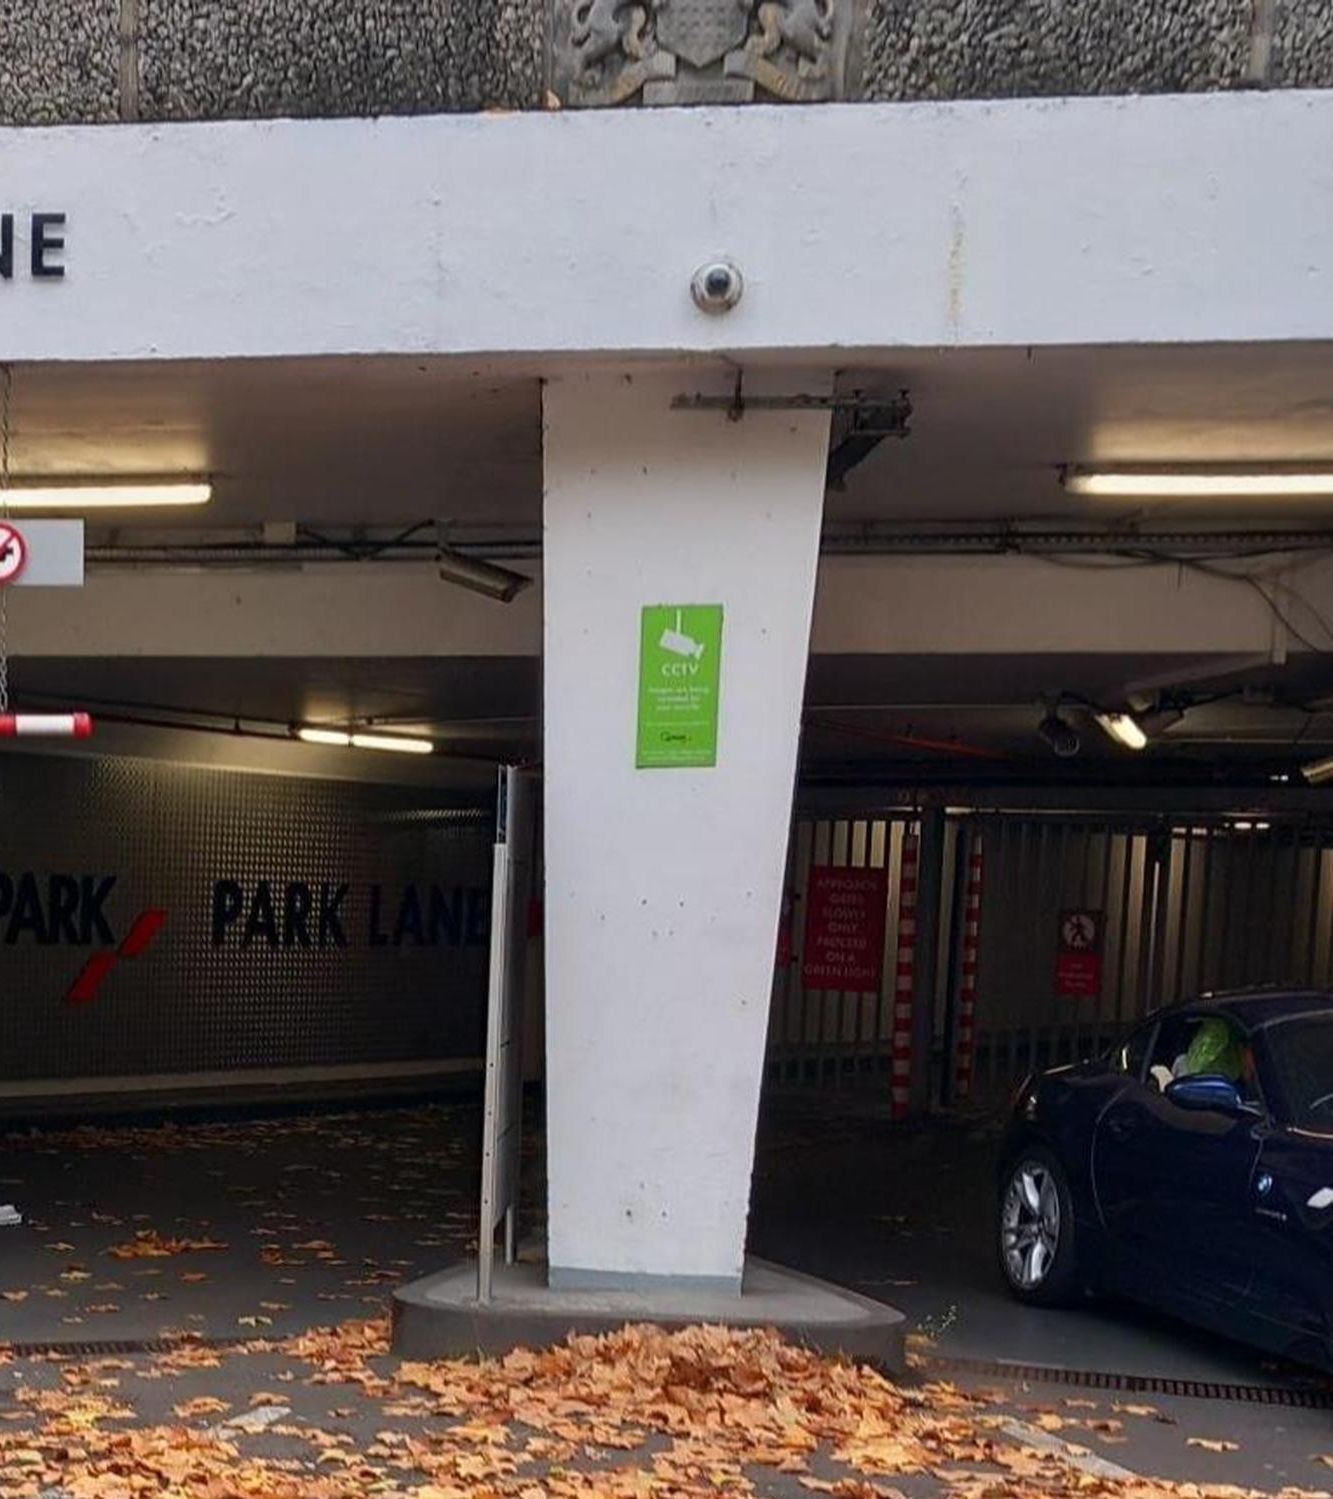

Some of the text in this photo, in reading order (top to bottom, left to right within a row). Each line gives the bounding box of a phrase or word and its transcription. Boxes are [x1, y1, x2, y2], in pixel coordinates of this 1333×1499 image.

[660, 662, 700, 677] CCTV
[211, 879, 350, 947] PARK
[366, 882, 491, 947] LANE
